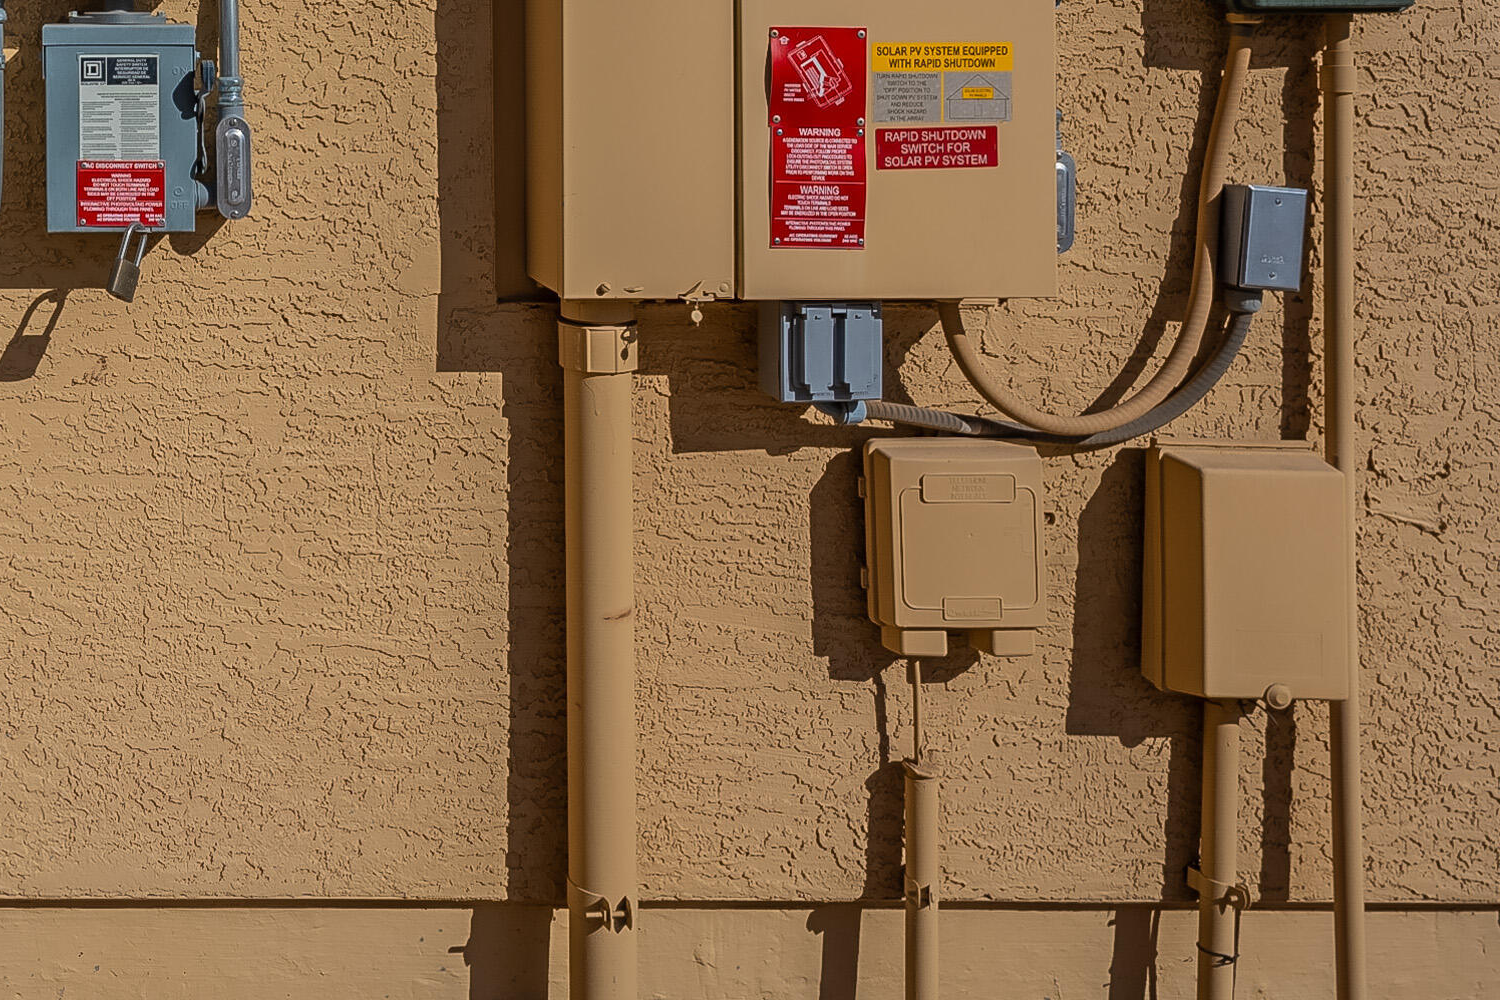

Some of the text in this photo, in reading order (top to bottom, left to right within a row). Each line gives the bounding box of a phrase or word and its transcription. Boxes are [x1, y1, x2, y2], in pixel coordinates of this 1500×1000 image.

[876, 46, 1008, 56] SOLAR PV SYSTEM EQUIPPED
[888, 59, 996, 68] WITH RAPID SHUTDOWN
[799, 128, 841, 136] WARNING
[884, 130, 986, 142] RAPID SHUTDOWN
[900, 142, 971, 154] SWITCH FOR
[884, 154, 988, 167] SOLAR PV SYSTEM
[800, 185, 840, 195] WARNING
